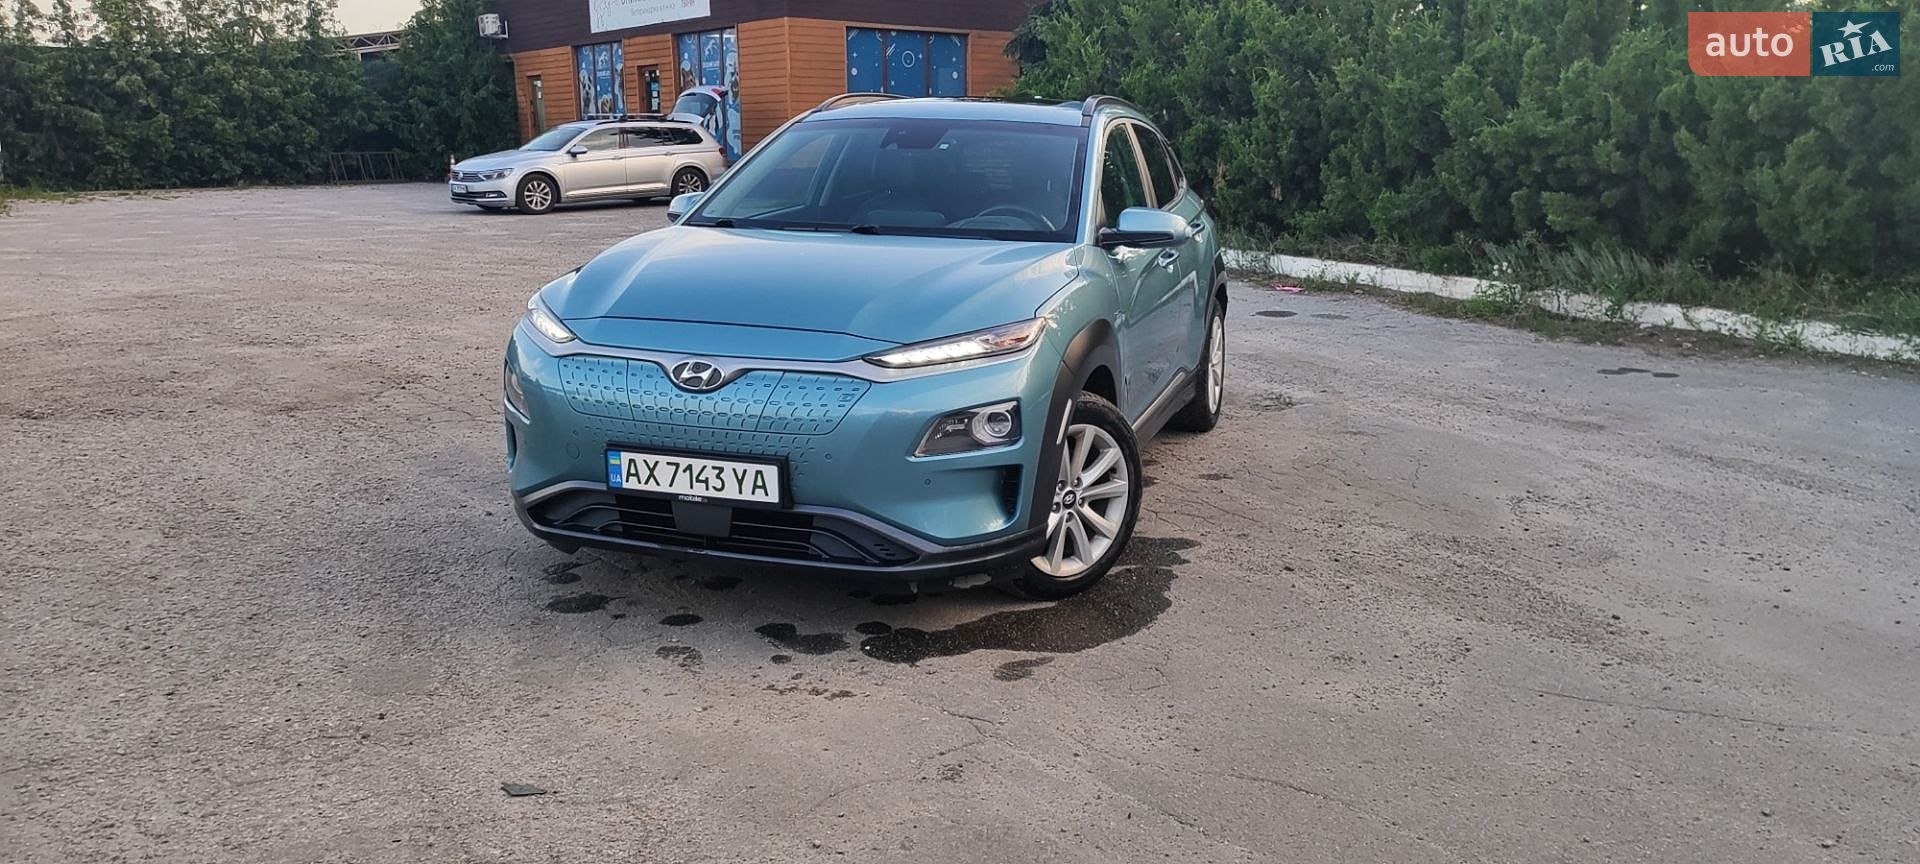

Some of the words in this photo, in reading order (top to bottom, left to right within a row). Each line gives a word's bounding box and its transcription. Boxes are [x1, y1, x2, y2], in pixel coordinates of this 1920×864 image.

[610, 473, 622, 483] UA
[625, 458, 661, 487] AX
[666, 461, 726, 493] 7143
[732, 467, 769, 497] YA
